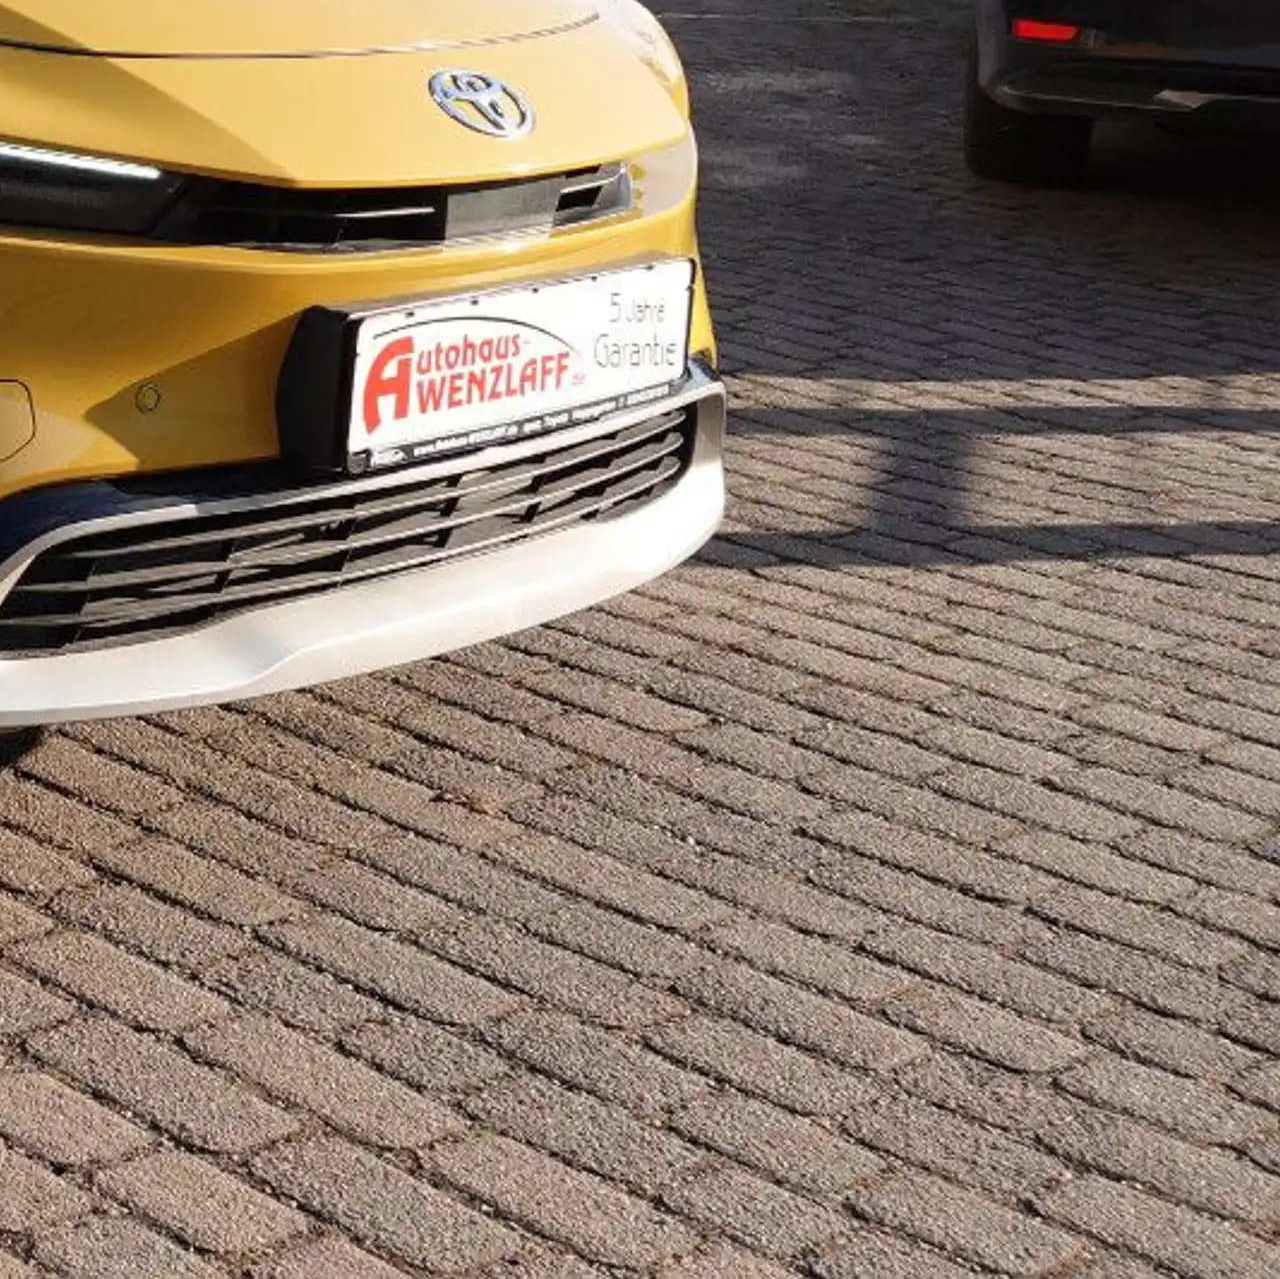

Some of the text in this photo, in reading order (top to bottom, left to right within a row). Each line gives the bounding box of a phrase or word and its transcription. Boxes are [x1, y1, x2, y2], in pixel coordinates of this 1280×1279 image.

[609, 292, 666, 324] 5 Jahre
[593, 332, 678, 368] Garantie
[416, 352, 570, 415] WENZLAFF
